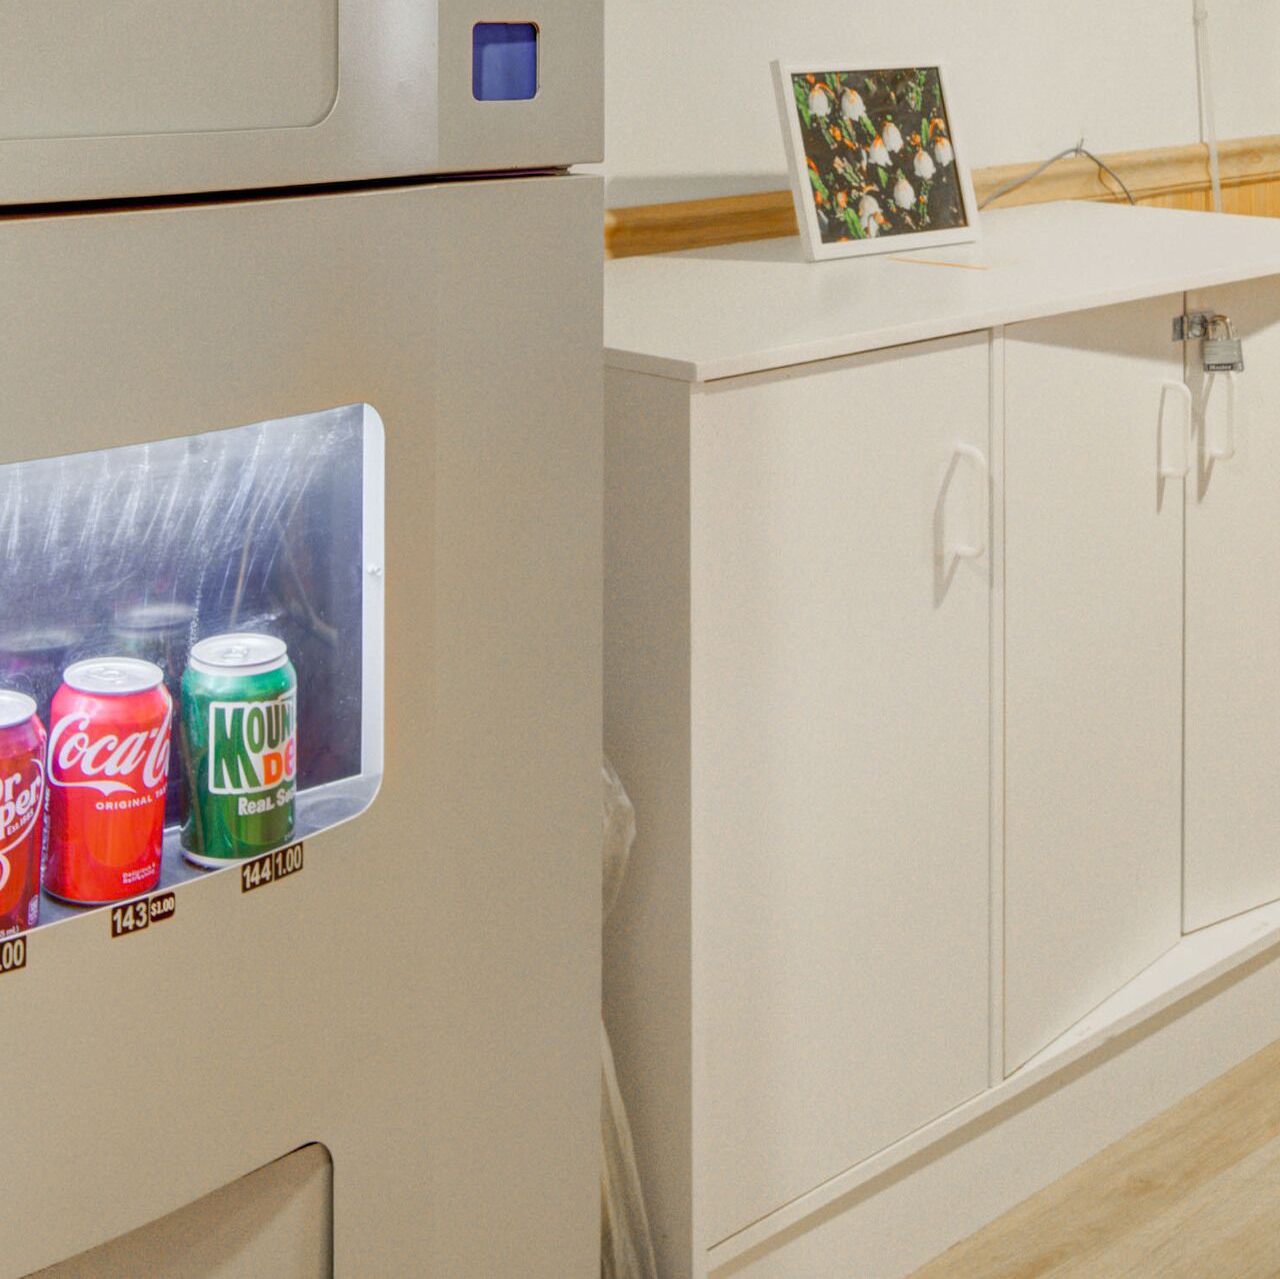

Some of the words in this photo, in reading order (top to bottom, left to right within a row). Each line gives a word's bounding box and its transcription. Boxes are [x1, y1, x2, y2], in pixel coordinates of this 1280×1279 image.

[96, 795, 153, 811] ORIGINAL
[243, 858, 270, 889] 144
[276, 845, 302, 876] 1.00
[113, 905, 148, 934] 143
[150, 897, 175, 918] $1.00
